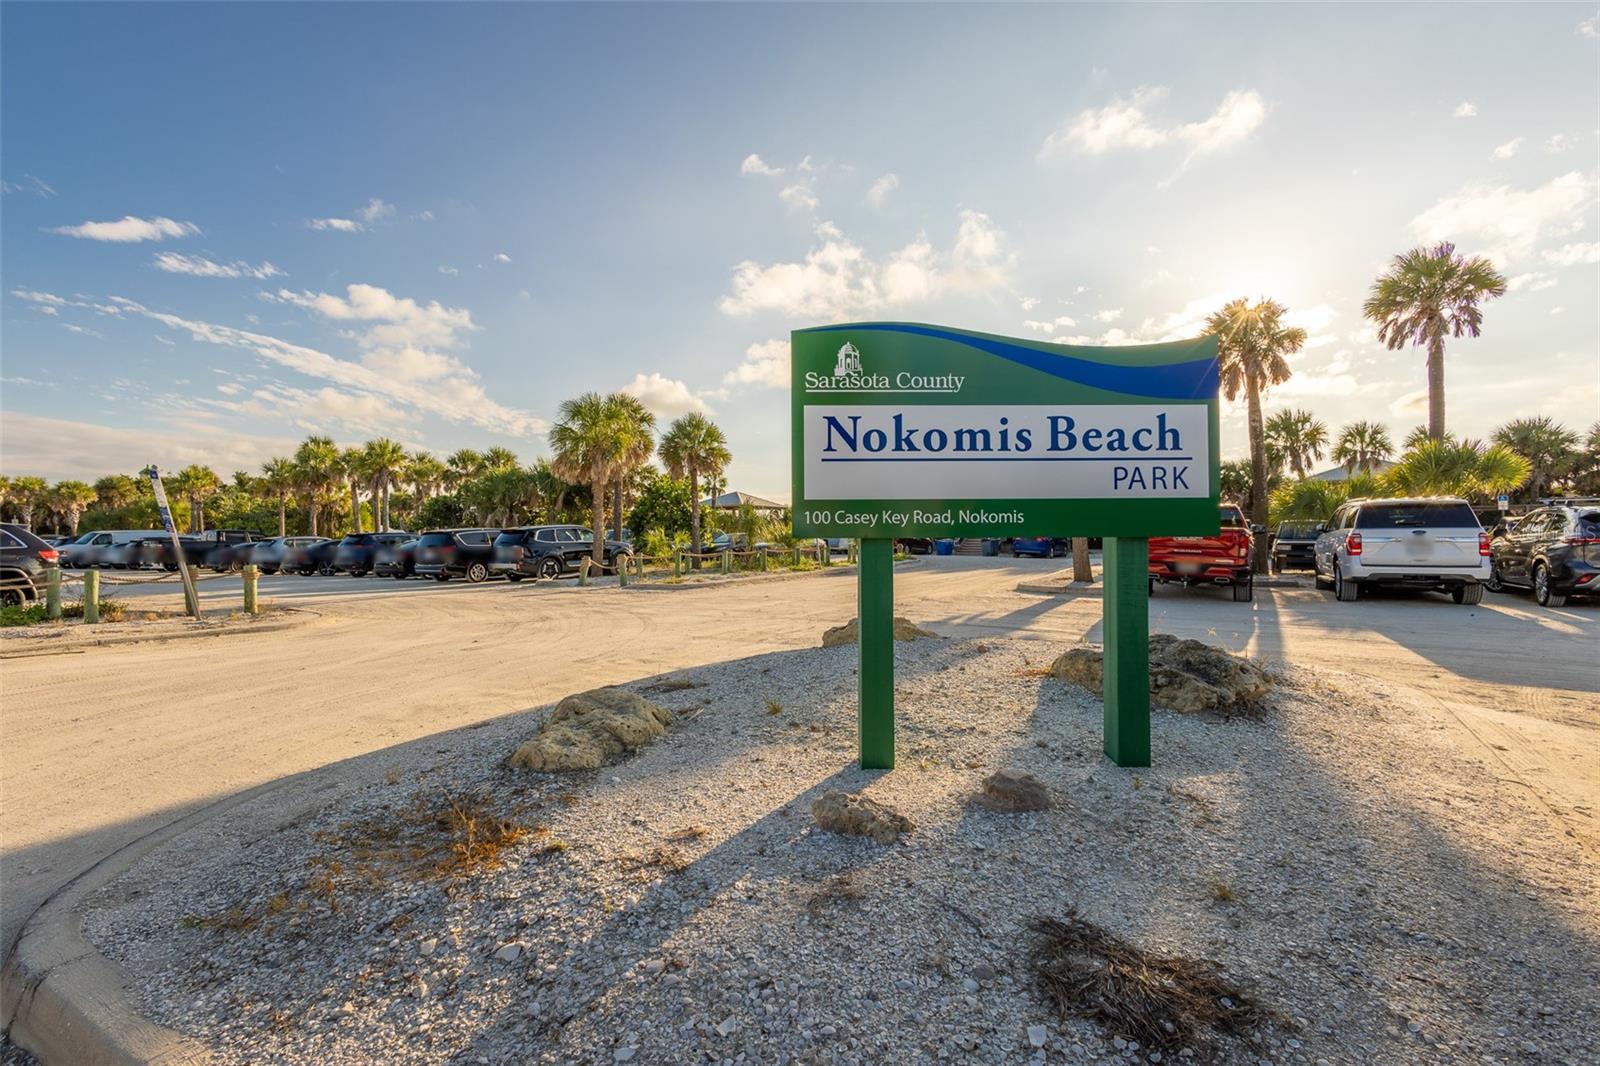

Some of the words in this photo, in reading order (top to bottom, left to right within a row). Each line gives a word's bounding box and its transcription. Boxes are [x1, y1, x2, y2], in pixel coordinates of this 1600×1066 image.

[805, 371, 890, 390] Sarasota
[896, 372, 965, 393] County
[822, 412, 1033, 453] Nokomis
[1046, 412, 1184, 453] Beach
[1113, 465, 1190, 491] PARK
[804, 510, 831, 524] 100
[834, 510, 878, 528] Casey
[882, 510, 910, 527] Key
[913, 510, 955, 526] Road,
[959, 510, 1025, 523] Nokomis
